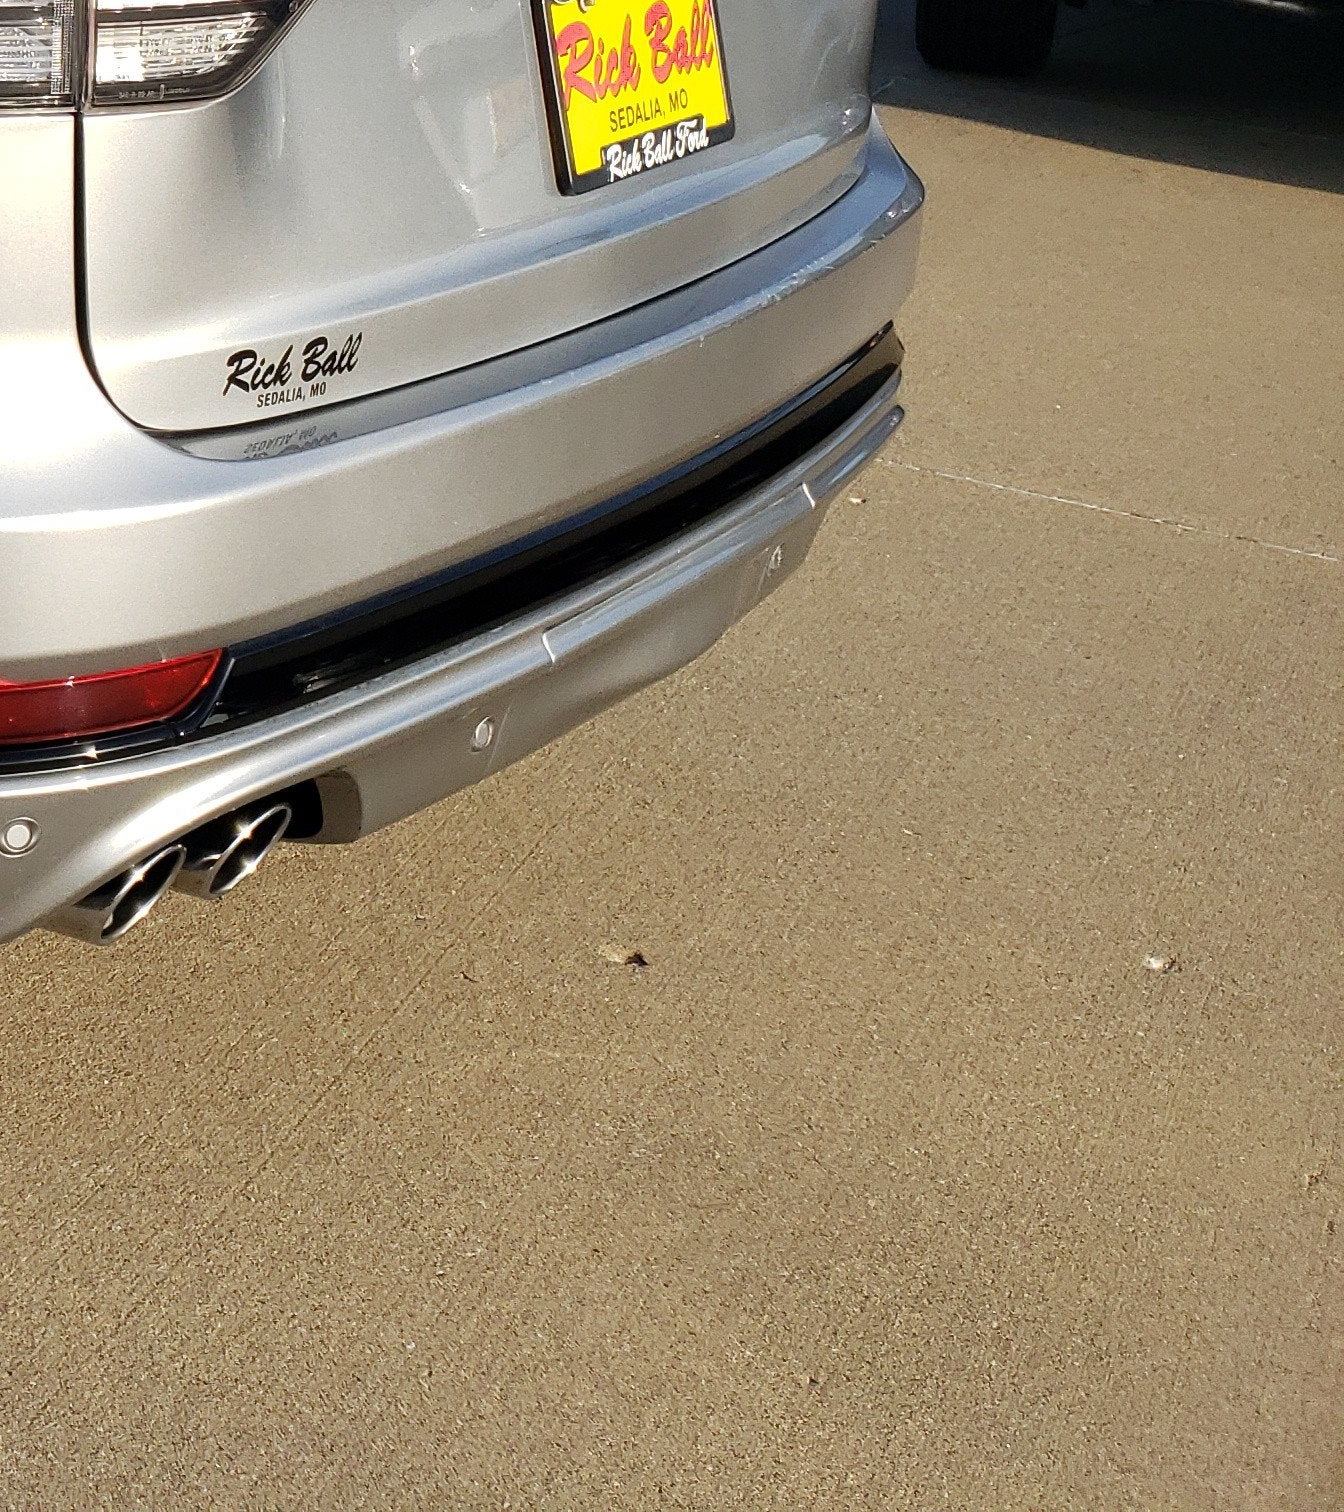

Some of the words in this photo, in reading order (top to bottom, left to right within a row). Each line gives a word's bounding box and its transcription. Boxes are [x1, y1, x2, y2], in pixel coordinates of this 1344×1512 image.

[555, 14, 641, 111] Rick
[609, 98, 666, 133] SEDALIA,
[669, 88, 689, 112] MO
[606, 145, 642, 182] Rick
[641, 131, 674, 169] Ball
[675, 118, 709, 158] Ford
[222, 344, 293, 397] Rick
[301, 331, 363, 384] Ball
[256, 385, 306, 408] SEDALIA,
[309, 381, 327, 397] MO
